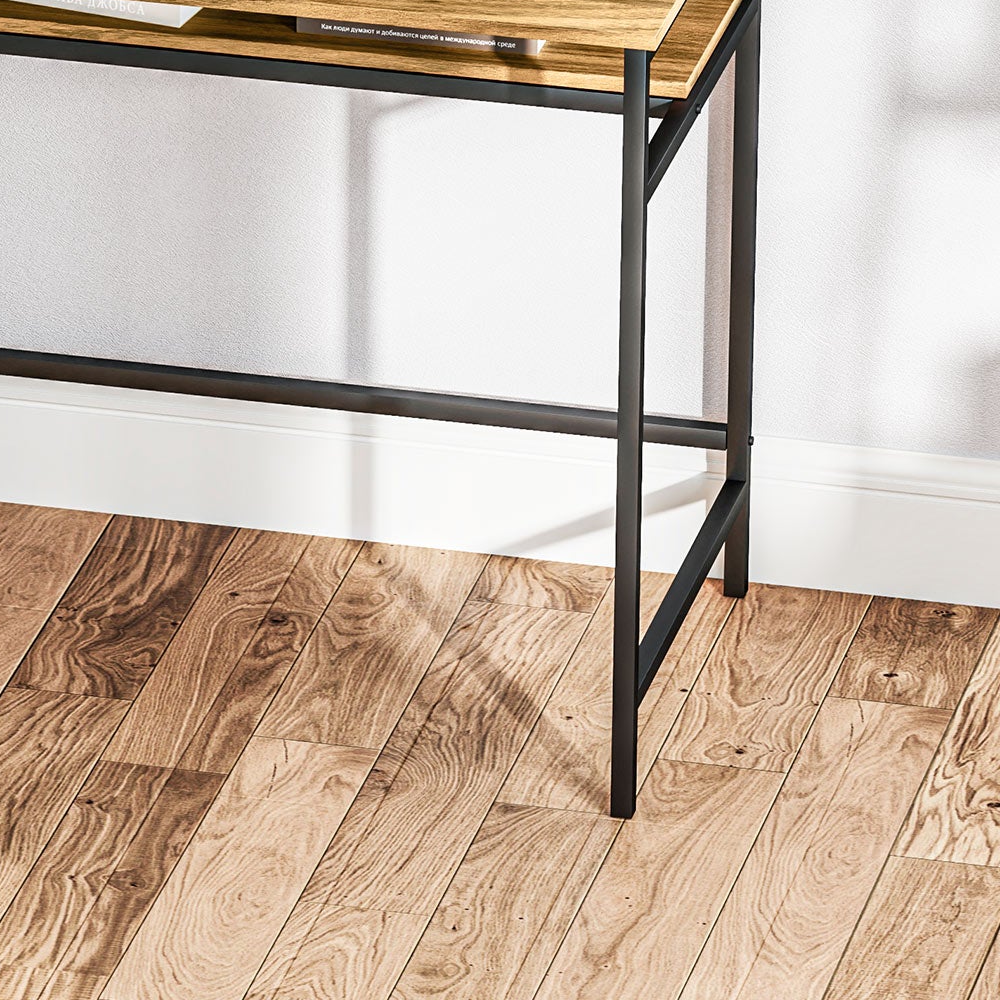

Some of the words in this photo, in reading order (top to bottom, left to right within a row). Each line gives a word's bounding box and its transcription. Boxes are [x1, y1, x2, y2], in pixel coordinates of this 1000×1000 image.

[320, 23, 332, 31] Как
[381, 29, 419, 39] добиваются
[445, 36, 496, 46] международной
[497, 41, 516, 49] среде
